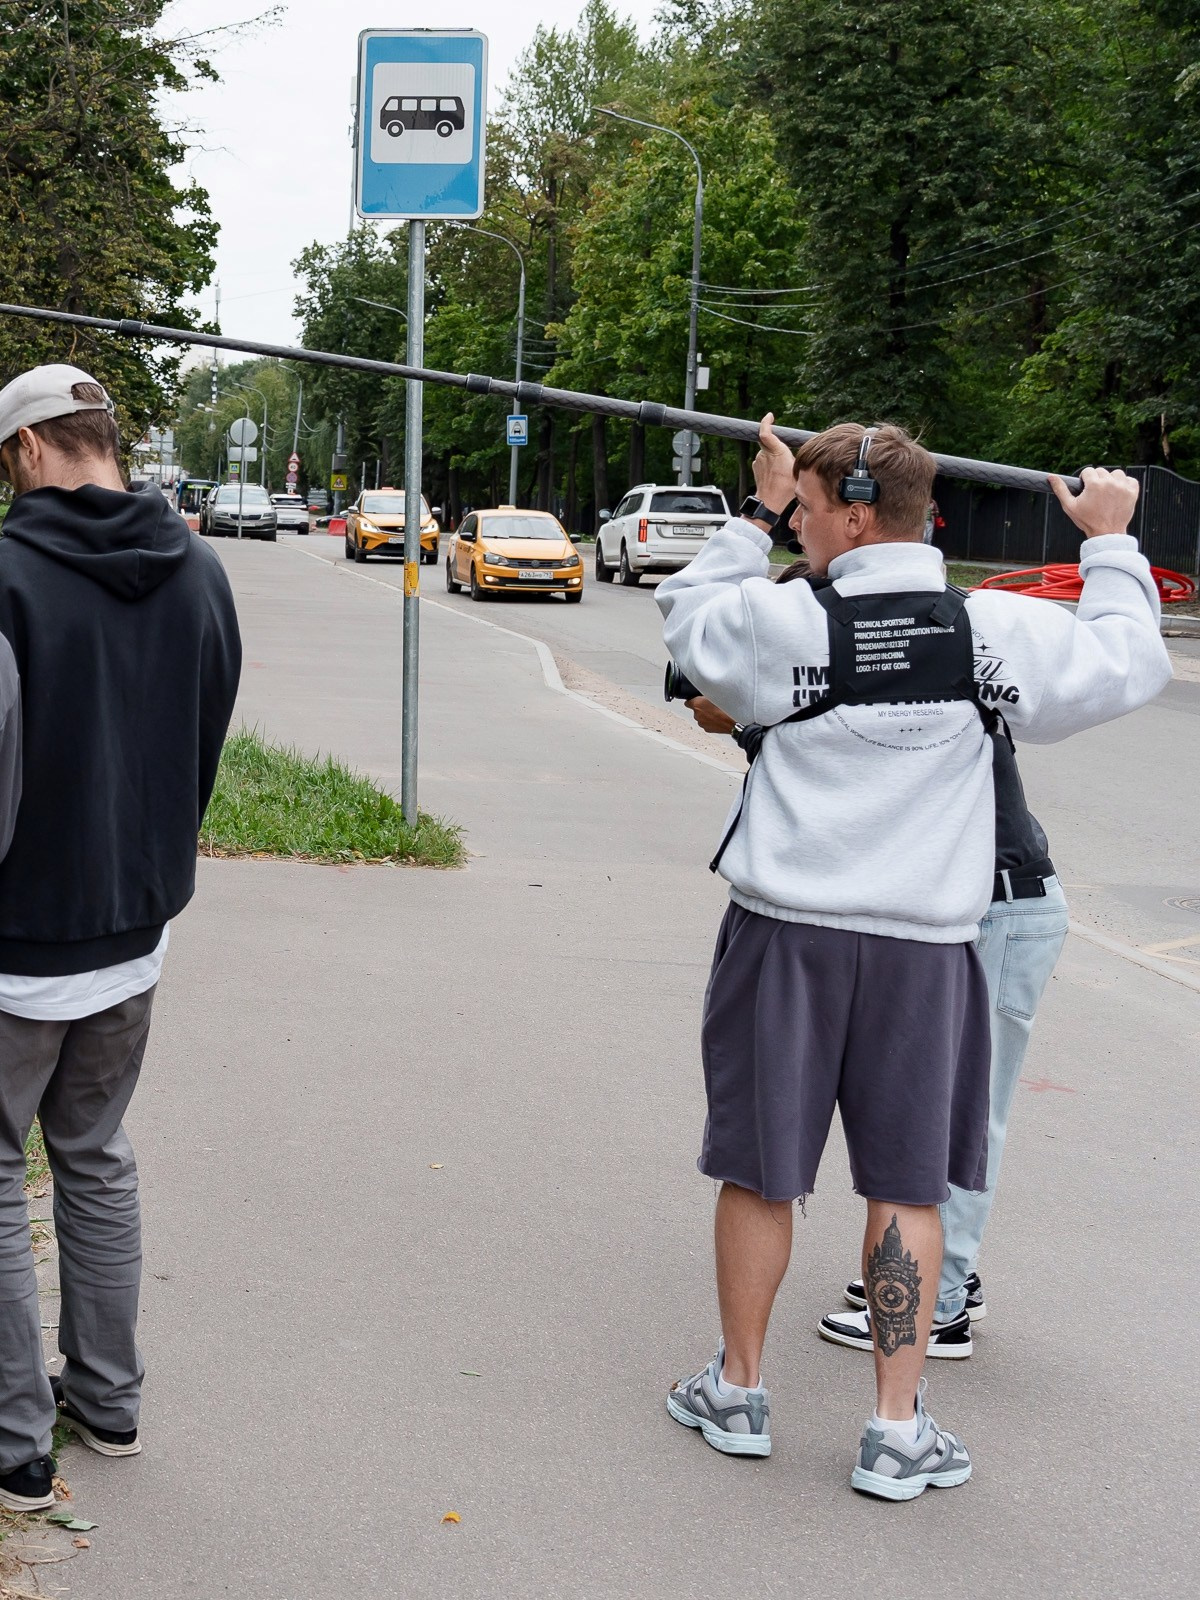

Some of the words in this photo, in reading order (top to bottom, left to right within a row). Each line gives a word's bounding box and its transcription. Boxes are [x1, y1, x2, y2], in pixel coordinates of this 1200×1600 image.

[854, 619, 881, 629] TECHNICAL
[854, 631, 880, 640] PRINCIPLE
[880, 630, 892, 639] USE:
[893, 629, 902, 638] ALL
[902, 627, 931, 637] CONDITION
[856, 653, 880, 662] DESIGNED
[856, 664, 871, 673] LOGO:
[893, 661, 911, 670] GOING
[792, 666, 829, 686] I'M
[878, 710, 887, 718] MY
[888, 709, 911, 717] ENERGY
[912, 708, 944, 717] RESERVES
[876, 742, 903, 751] BALANCE
